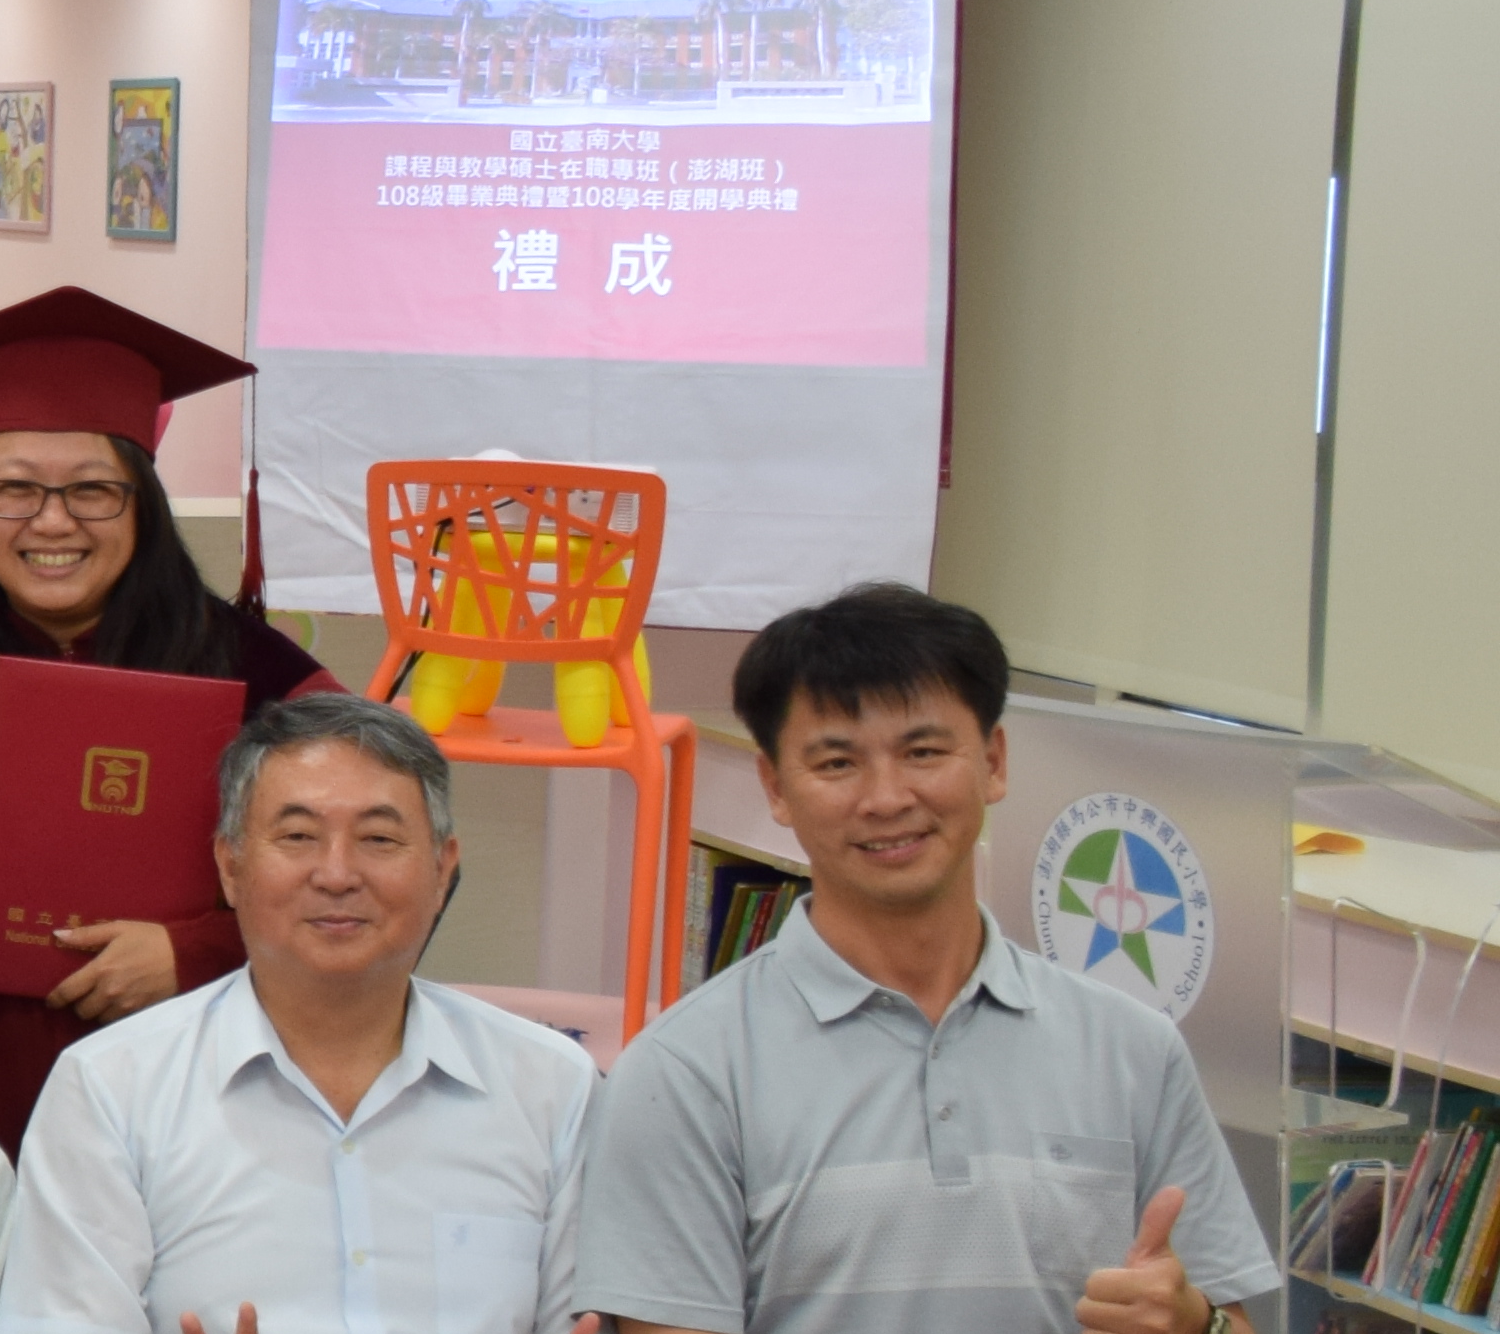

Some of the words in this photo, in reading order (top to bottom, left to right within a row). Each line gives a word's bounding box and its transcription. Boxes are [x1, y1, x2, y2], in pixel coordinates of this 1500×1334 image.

[509, 129, 660, 153] 國立臺南大學
[1174, 934, 1206, 1002] School
